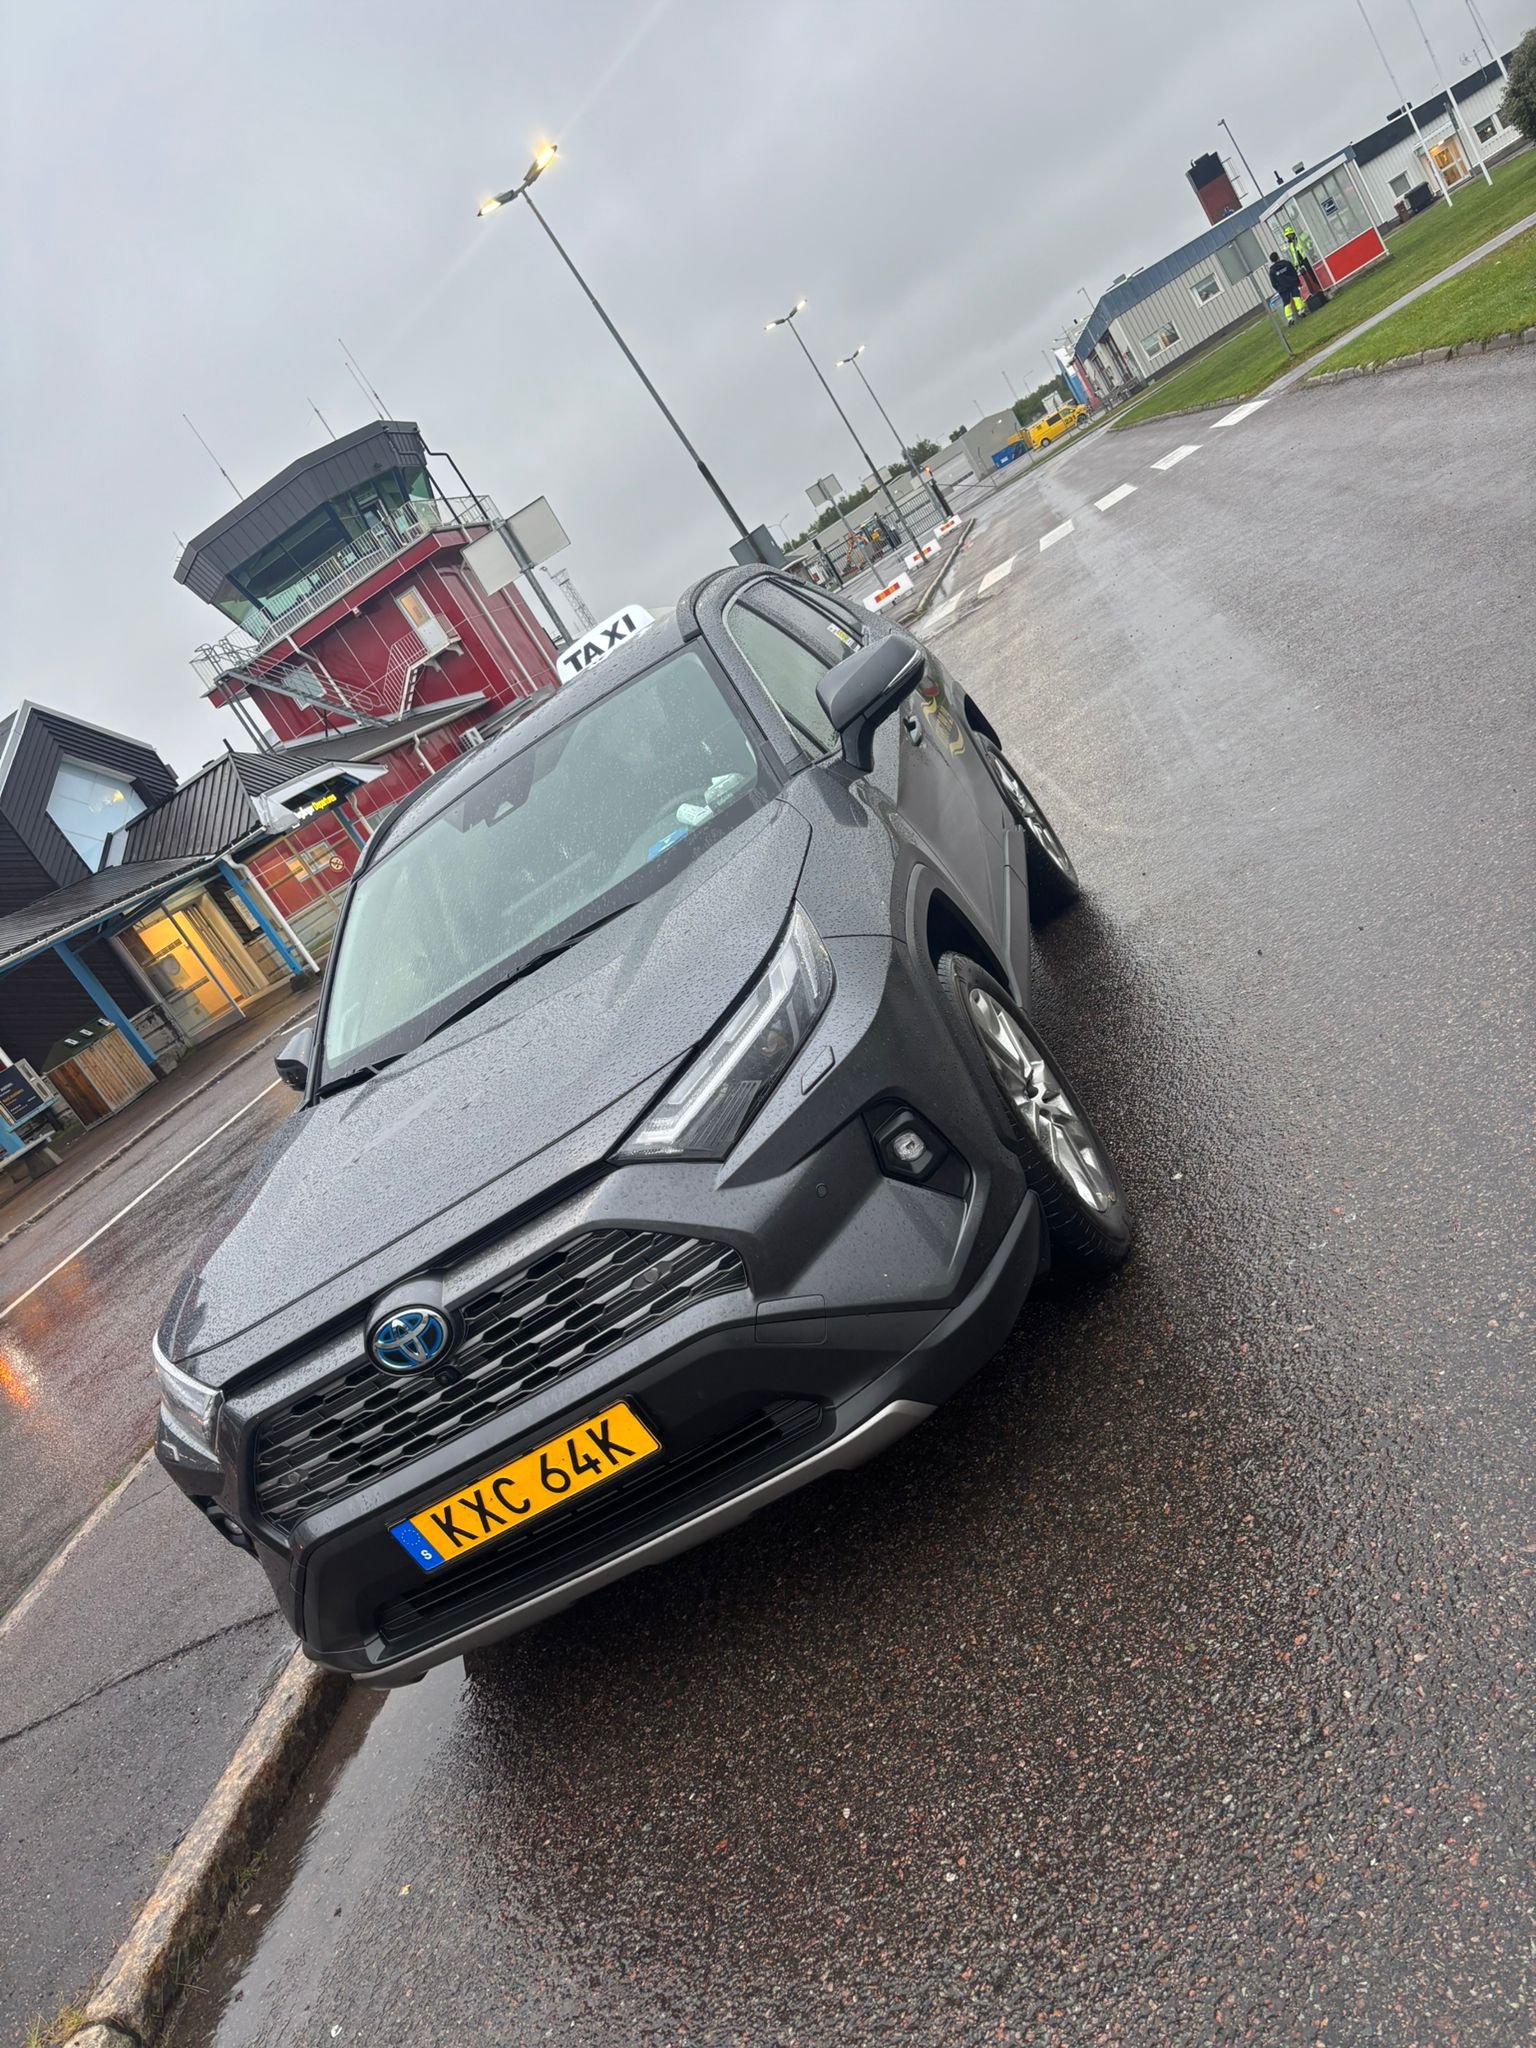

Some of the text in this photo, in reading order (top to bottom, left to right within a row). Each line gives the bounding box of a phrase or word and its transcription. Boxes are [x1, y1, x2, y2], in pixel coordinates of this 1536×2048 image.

[563, 613, 637, 673] TAXI
[430, 1418, 637, 1549] KXC 64K
[420, 1548, 433, 1561] S
